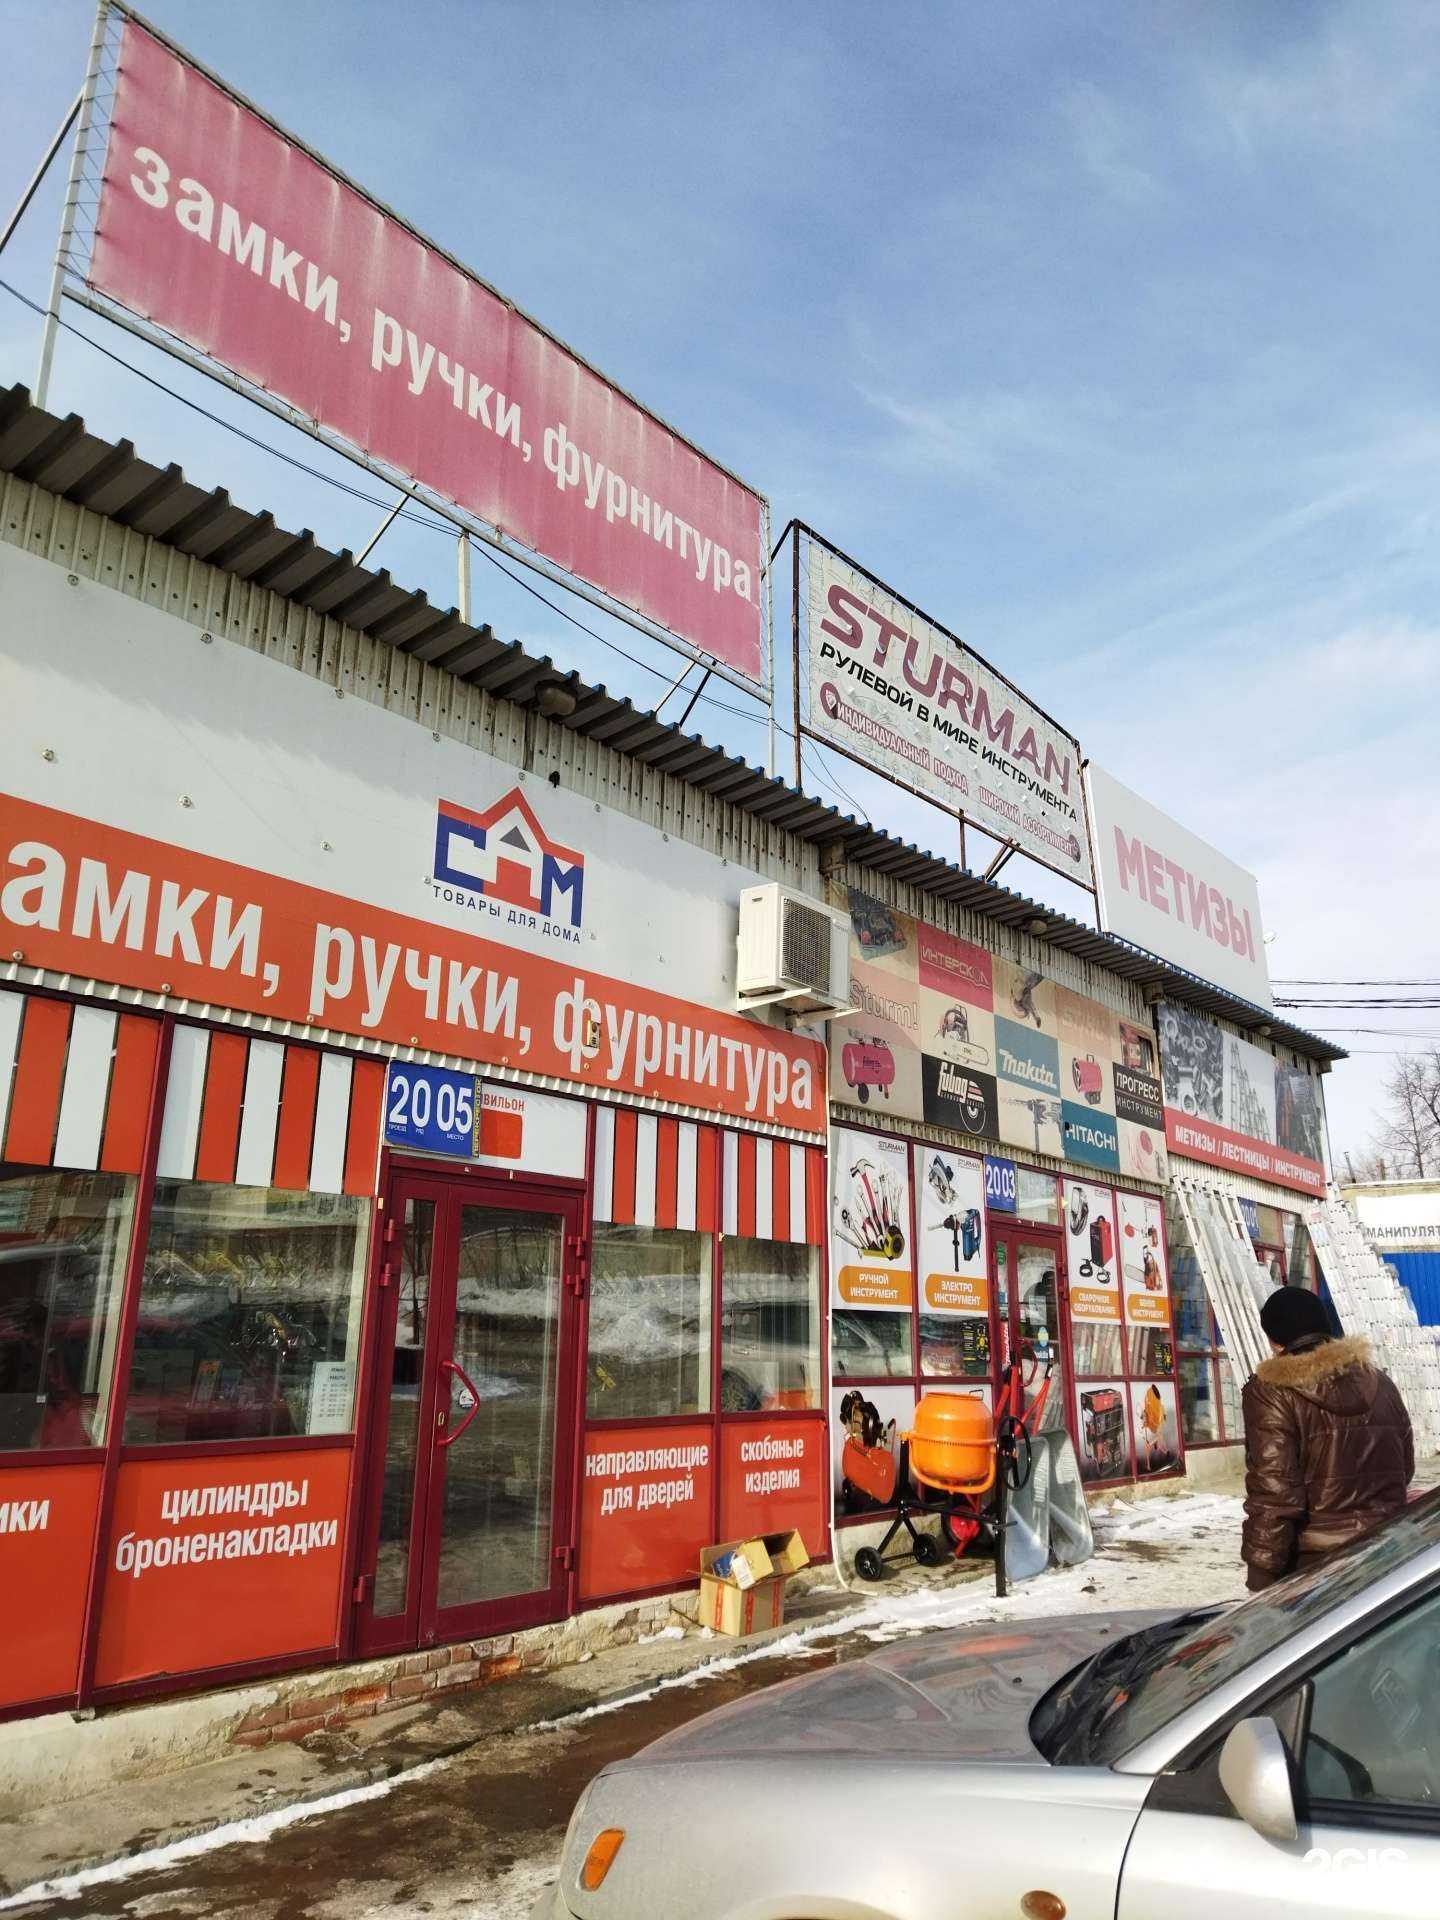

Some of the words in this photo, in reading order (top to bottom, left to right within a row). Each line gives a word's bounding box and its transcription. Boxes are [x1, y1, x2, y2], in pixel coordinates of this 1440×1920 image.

[371, 308, 532, 461] ручки,
[543, 422, 752, 600] фурнитура
[820, 584, 1071, 795] STURMAN
[820, 642, 914, 712] РУЛЕВОЙ
[917, 704, 930, 722] В
[933, 714, 979, 754] МИРЕ
[981, 746, 1077, 822] ИНСТРУМЕНТА
[836, 701, 931, 770] ИНДИВИДУАЛЬНЫЙ
[934, 758, 969, 796] ПОДХОД
[980, 785, 1021, 825] ШИРОКИЙ
[1113, 824, 1255, 963] МЕТИЗЫ
[432, 884, 501, 917] ТОВАРЫ
[507, 908, 537, 930] ДЛЯ
[542, 921, 581, 945] ДОМА
[0, 841, 281, 997] амки,
[308, 922, 532, 1056] ручки,
[553, 978, 812, 1118] фурнитура
[921, 945, 991, 986] ИНТЕРСКОЛ
[389, 1075, 474, 1134] 2005
[1116, 1073, 1160, 1101] ПРОГРЕСС
[1116, 1095, 1162, 1121] ИНСТРУМЕНТ
[1066, 1123, 1117, 1151] HITACHI
[1175, 1124, 1216, 1153] МЕТИЗЫ
[1221, 1142, 1270, 1172] ЛЕСТНИЦЫ
[1275, 1160, 1321, 1185] ИНСТРУМЕНТ
[985, 1164, 1016, 1199] 2003
[850, 1287, 899, 1299] ИНСТРУМЕНТ
[859, 1272, 889, 1284] РУЧНОЙ
[941, 1280, 973, 1293] ЭЛЕКТРО
[934, 1292, 981, 1306] ИНСТРУМЕНТ
[585, 1444, 709, 1480] направляющие
[740, 1434, 804, 1463] скобяные
[160, 1479, 308, 1525] цилиндры
[601, 1485, 633, 1516] для
[637, 1474, 694, 1511] дверей
[745, 1467, 800, 1496] изделия
[115, 1518, 338, 1578] броненакладки
